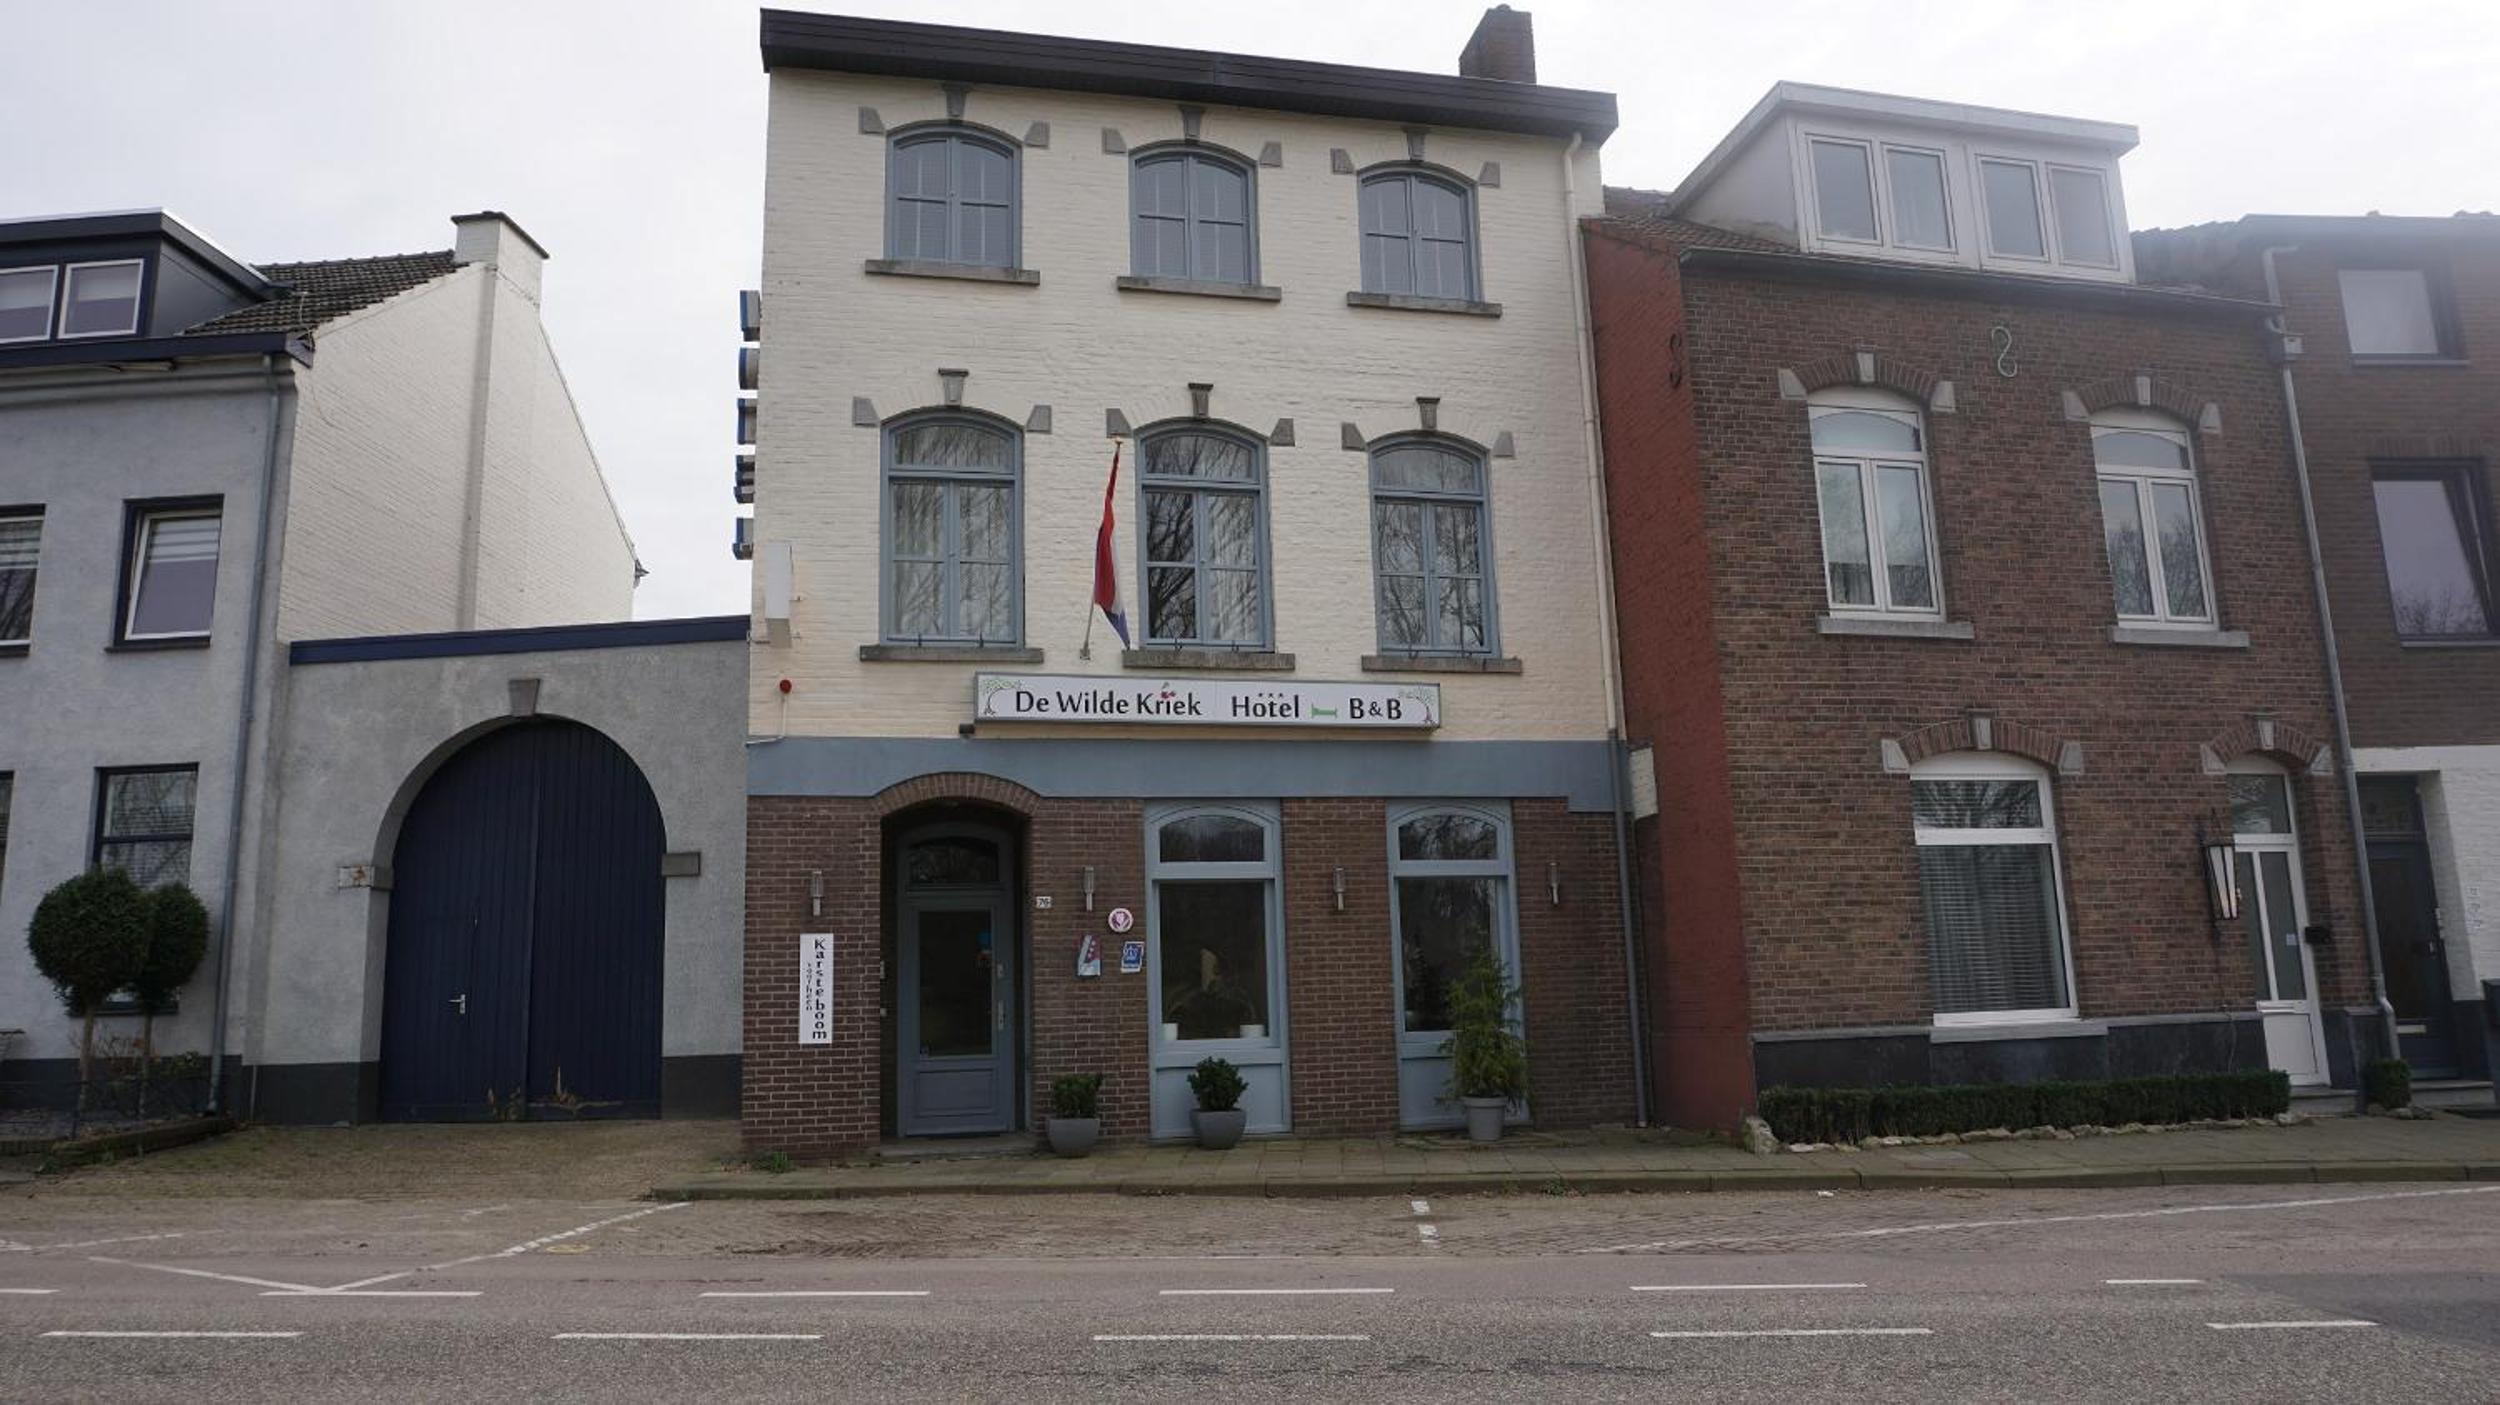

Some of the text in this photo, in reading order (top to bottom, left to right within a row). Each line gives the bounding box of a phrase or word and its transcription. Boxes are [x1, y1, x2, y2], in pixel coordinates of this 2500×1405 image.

[1015, 690, 1050, 713] De
[1056, 689, 1129, 715] Wilde
[1136, 691, 1203, 716] Kriek
[812, 937, 828, 1040] Karsteboom
